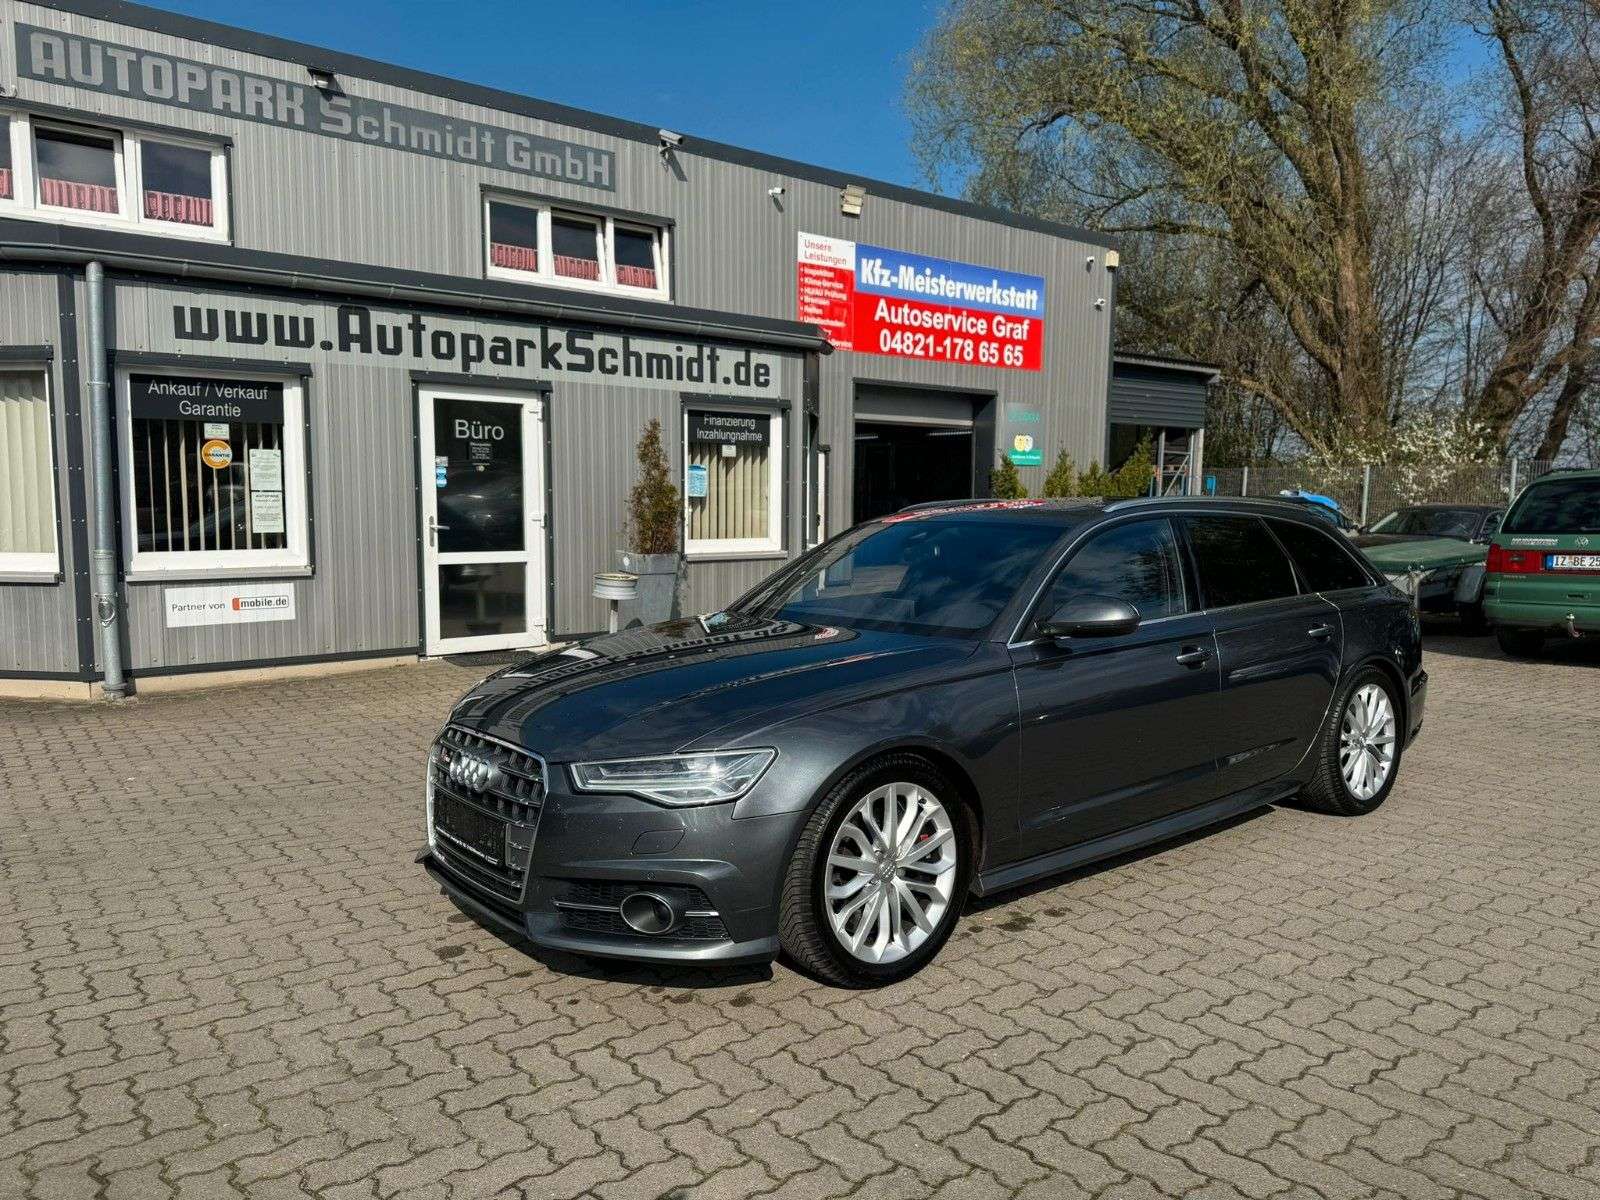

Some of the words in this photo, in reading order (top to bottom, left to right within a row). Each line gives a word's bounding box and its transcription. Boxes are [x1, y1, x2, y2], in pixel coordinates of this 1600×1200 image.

[30, 32, 305, 126] AUTOPARK
[320, 96, 495, 163] Schmidt
[506, 133, 610, 186] GmbH
[804, 239, 832, 251] Unsere
[804, 250, 847, 265] Leistungen
[860, 258, 1038, 311] Kfz-Meisterwerkstatt
[874, 298, 987, 335] Autoservice
[992, 315, 1030, 341] Graf
[173, 305, 771, 388] www.AutoparkSchmidt.de
[879, 328, 973, 361] 04821-178
[979, 342, 999, 364] 65
[1003, 345, 1024, 367] 65
[148, 379, 201, 397] Ankauf
[204, 382, 210, 397] /
[214, 383, 269, 400] Verkauf
[179, 400, 241, 417] Garantie
[455, 419, 504, 440] Büro
[704, 414, 756, 430] Finanzierung
[697, 428, 763, 443] Inzahlungnahme
[1555, 555, 1567, 567] IZ
[1573, 556, 1586, 567] BE
[172, 602, 206, 612] Partner
[208, 602, 226, 610] von
[240, 597, 287, 609] mobile.de
